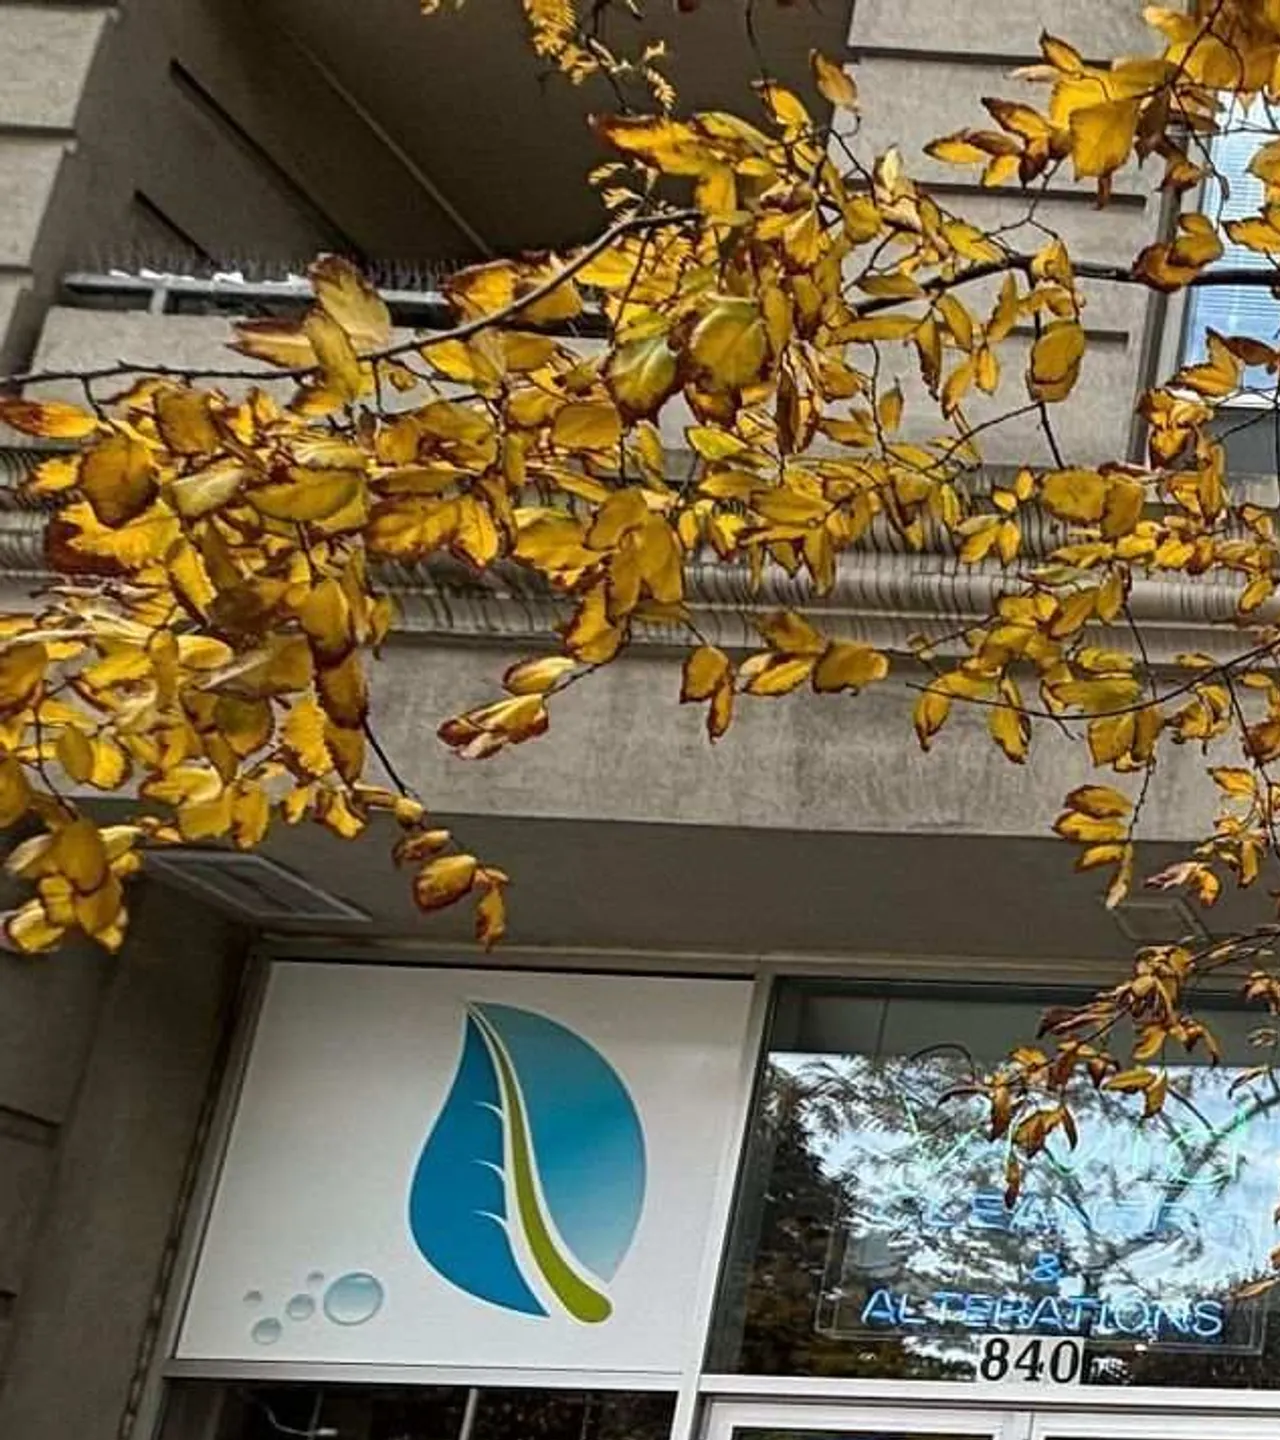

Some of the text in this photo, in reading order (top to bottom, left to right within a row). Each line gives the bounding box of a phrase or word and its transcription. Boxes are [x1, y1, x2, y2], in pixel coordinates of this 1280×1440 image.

[1027, 1251, 1063, 1284] &
[861, 1289, 1225, 1337] ALTERATIONS
[979, 1337, 1081, 1384] 840
